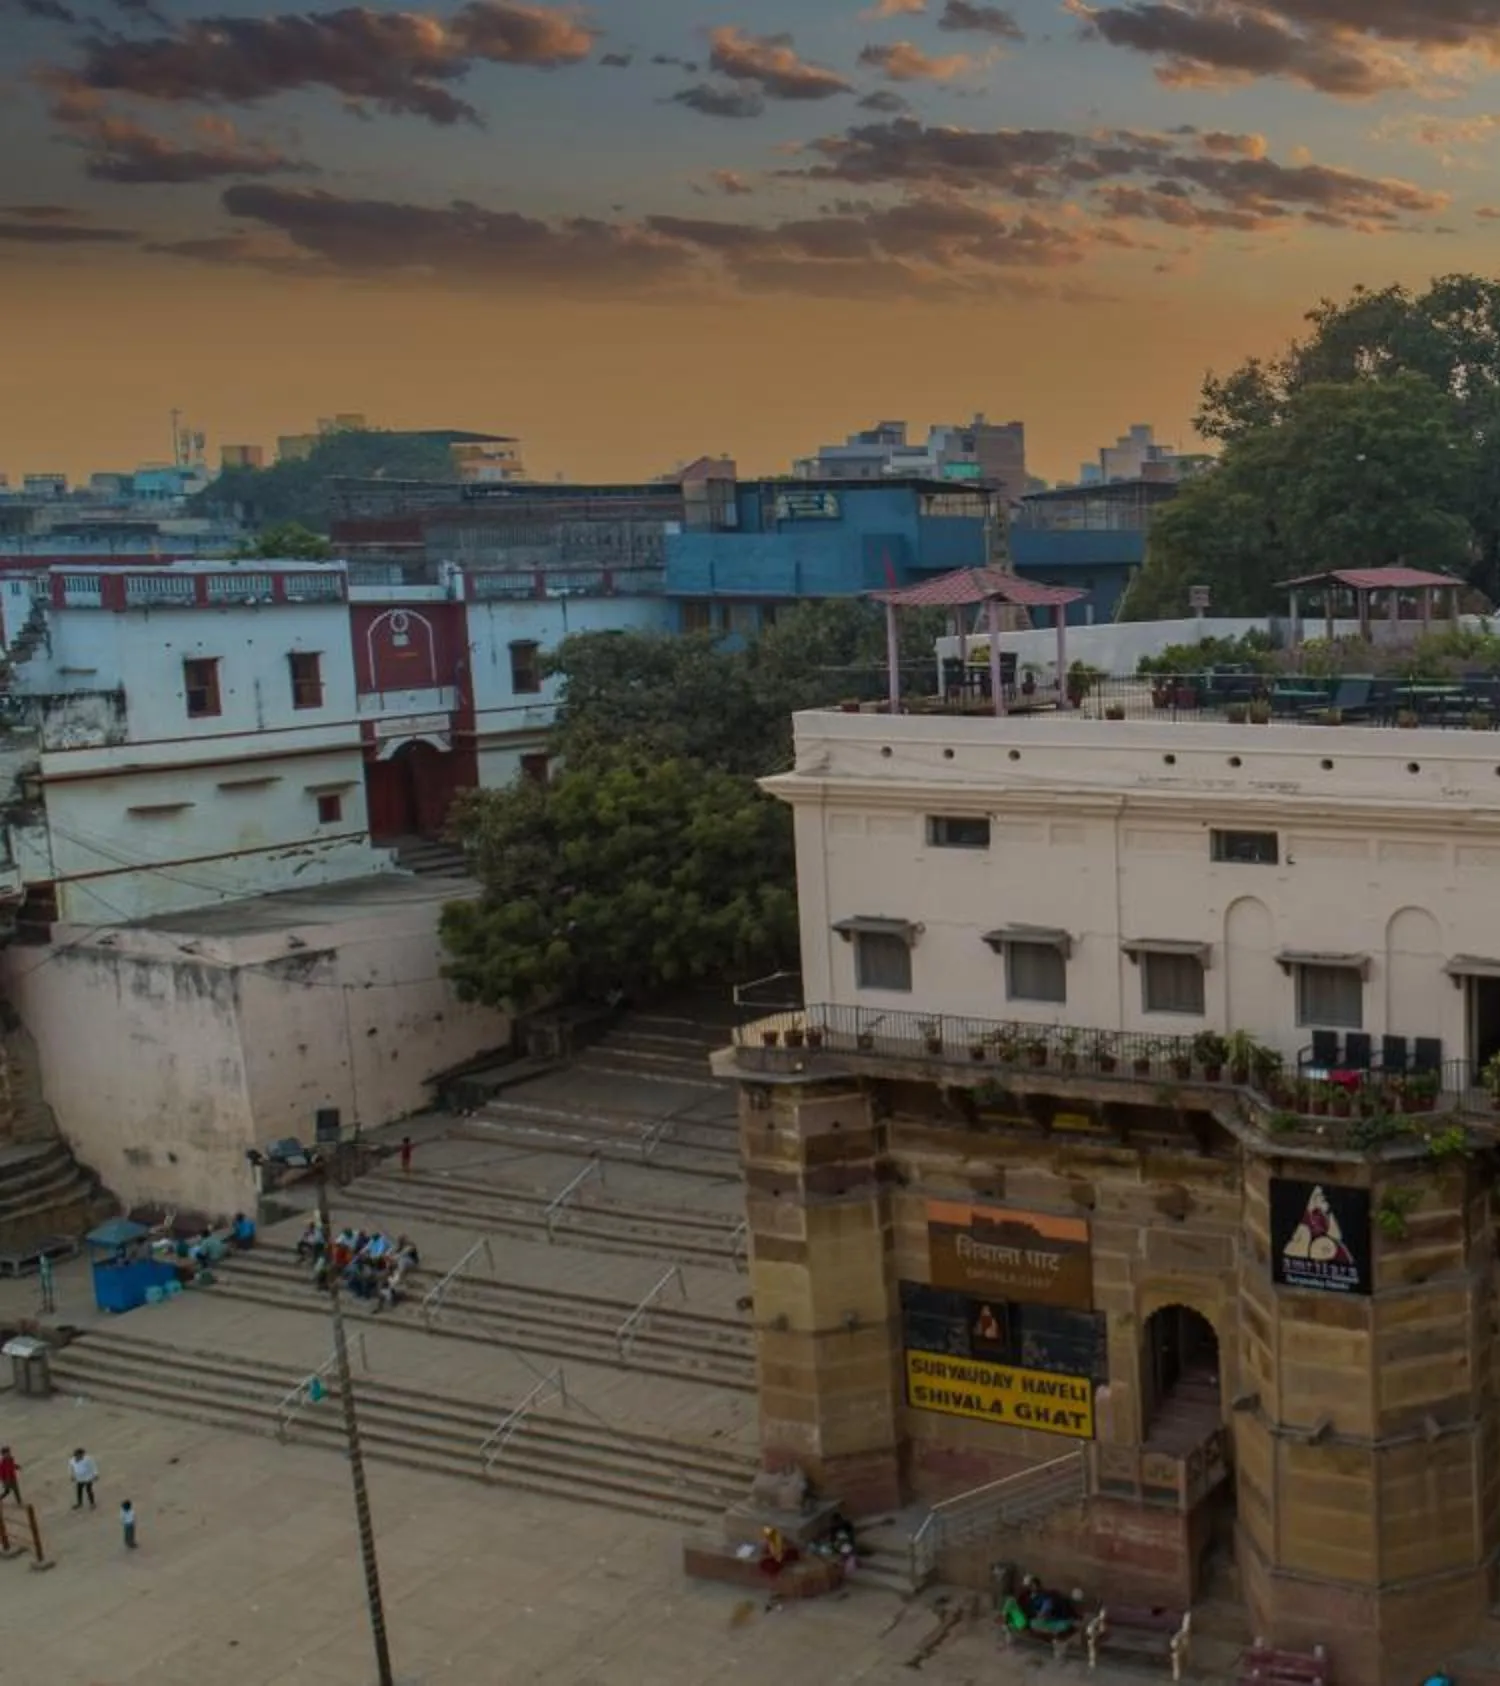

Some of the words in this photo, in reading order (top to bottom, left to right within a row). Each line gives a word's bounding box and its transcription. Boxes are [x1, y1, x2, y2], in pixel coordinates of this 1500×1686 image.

[912, 1358, 1012, 1388] SURYAUDAY
[1021, 1376, 1087, 1401] HAVELI
[914, 1386, 1004, 1414] SHIVALA
[1013, 1401, 1087, 1428] GHAT
